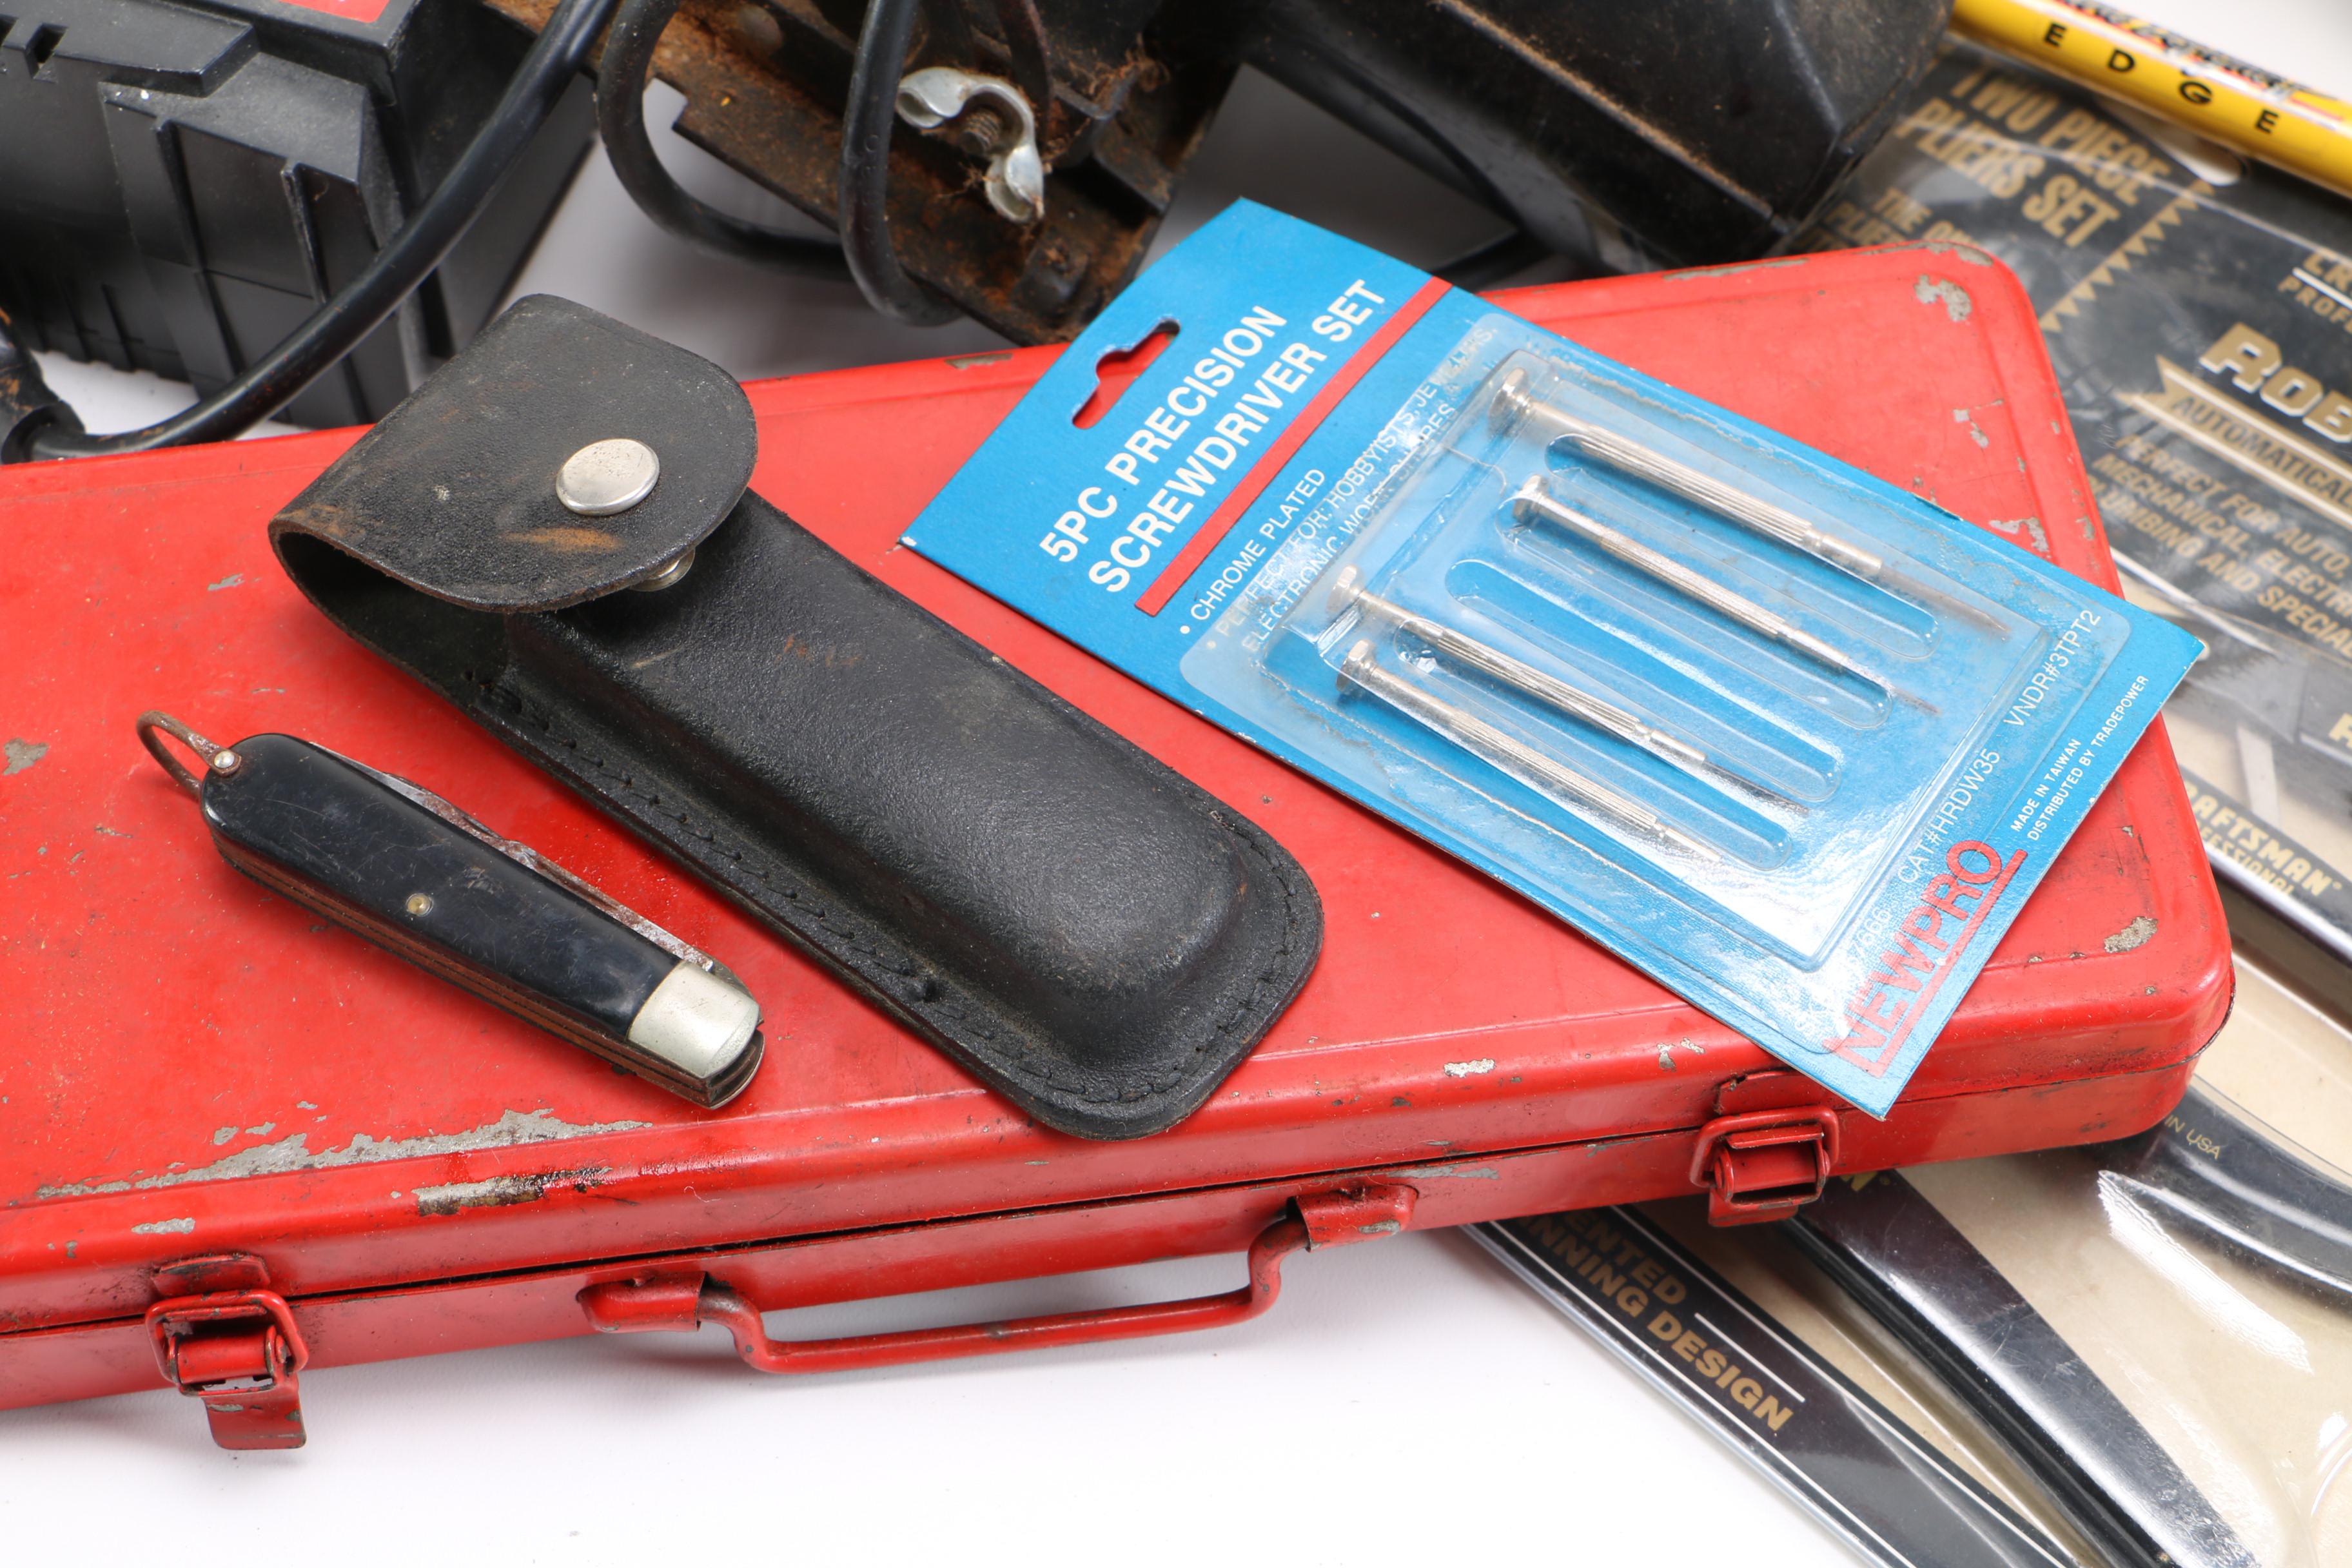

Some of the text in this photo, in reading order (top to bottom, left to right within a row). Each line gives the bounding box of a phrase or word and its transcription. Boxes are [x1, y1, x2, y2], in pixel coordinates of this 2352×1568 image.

[2043, 22, 2280, 135] EDGE
[1894, 97, 2121, 249] PLIERS SET
[2039, 107, 2171, 206] PIECE
[1039, 305, 1288, 562] 5PC PRECISION
[1088, 279, 1386, 593] SCREWDRIVER SET
[1190, 469, 1326, 620] CHROME PLATED
[2219, 493, 2280, 533] FOR
[1216, 548, 1290, 636] PERFECT
[2197, 551, 2260, 593] AND
[2003, 609, 2102, 727] VNDR#3TPT2
[2010, 738, 2082, 832] MADE IN TAIWAN
[2026, 675, 2150, 841] DISTRIBUTED BY TRADEPOWER
[2184, 780, 2333, 897] AFTSMAN
[1821, 839, 2003, 1073] NEWPRO
[2164, 1115, 2220, 1160] IN USA
[1563, 1209, 1687, 1304] ENTED
[1520, 1216, 1794, 1431] NNING DESIGN
